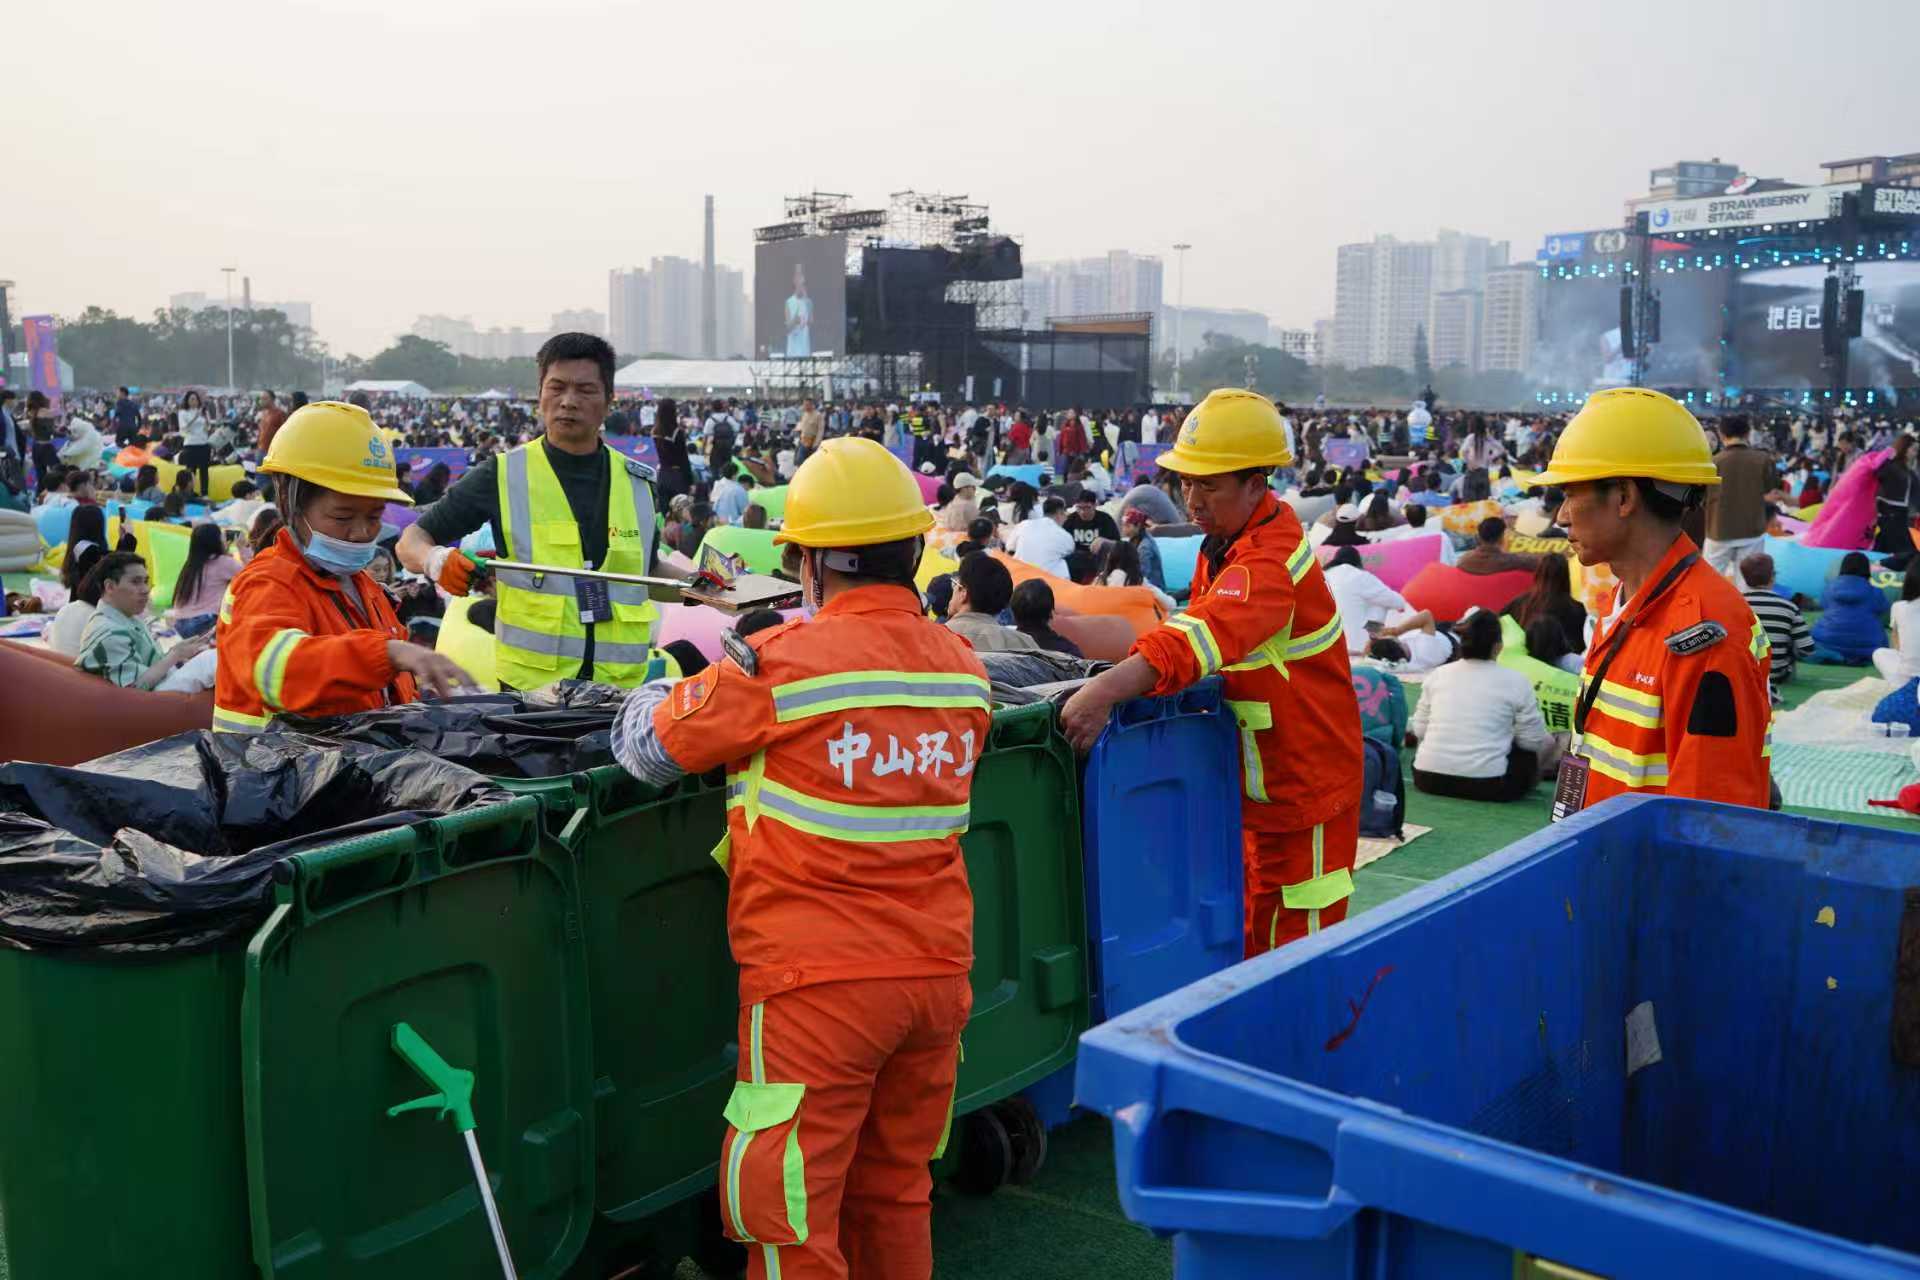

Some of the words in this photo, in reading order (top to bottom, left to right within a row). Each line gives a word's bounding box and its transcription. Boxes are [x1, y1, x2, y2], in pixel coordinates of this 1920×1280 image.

[1709, 193, 1810, 212] STRAWBERRY
[1708, 210, 1755, 223] STAGE
[1766, 305, 1822, 330] 把自己
